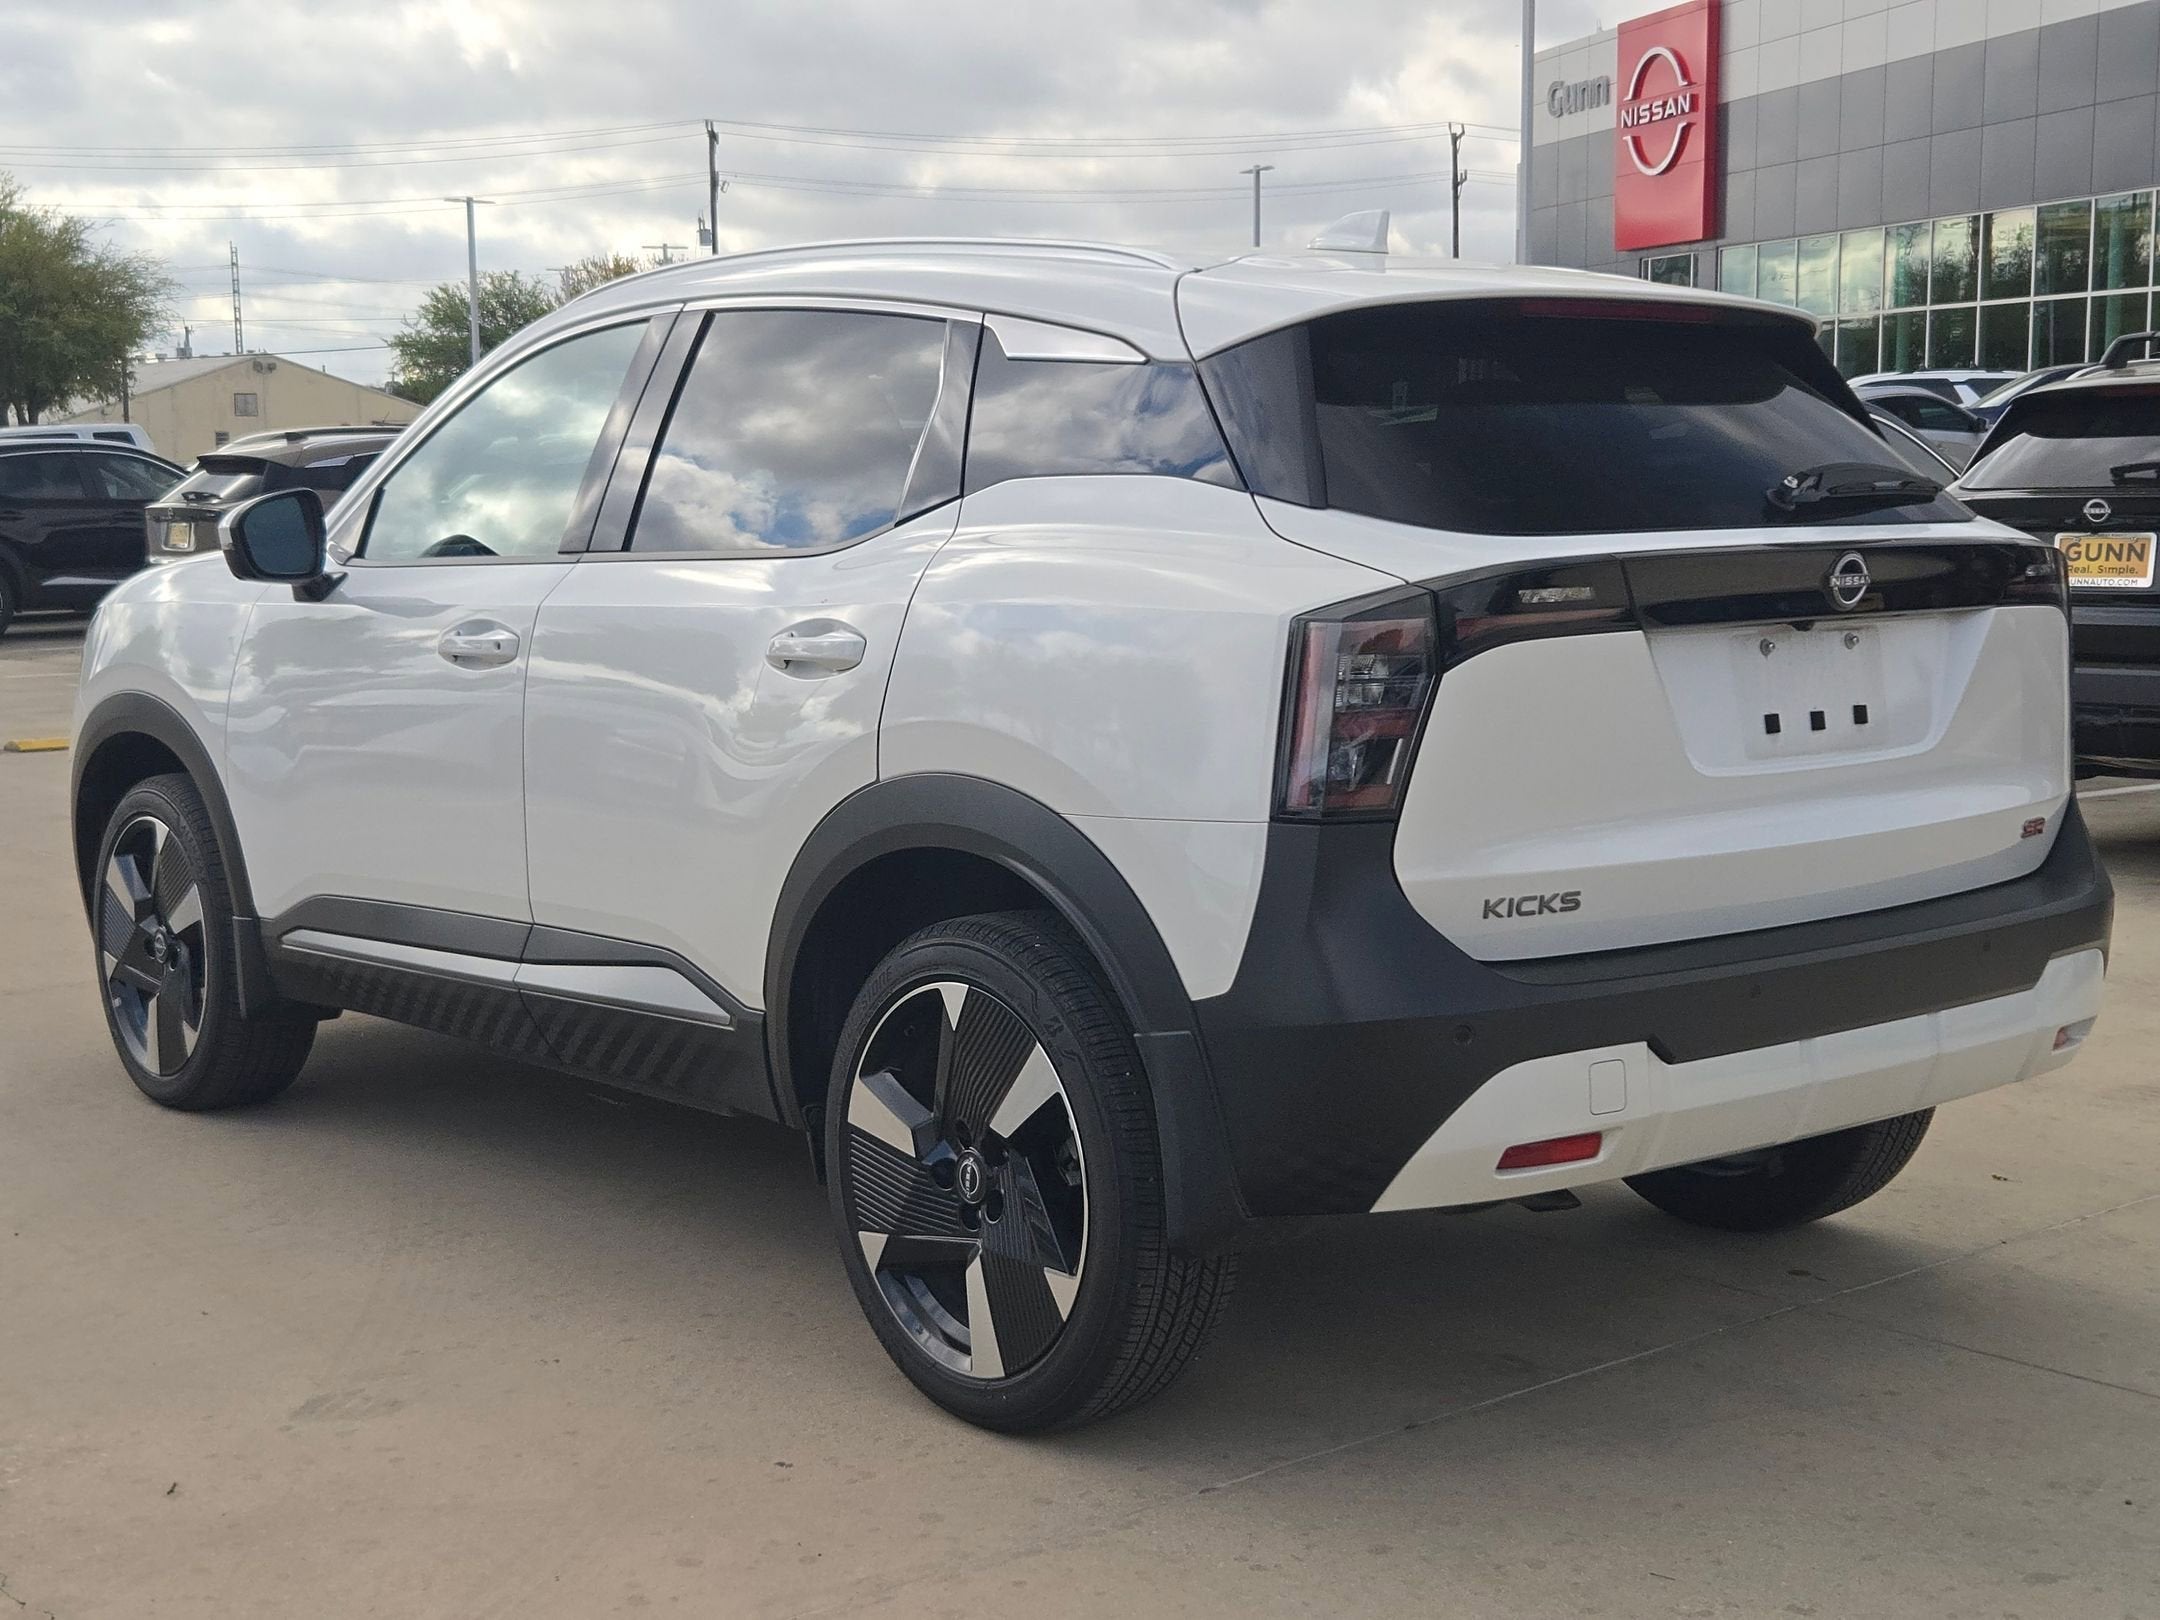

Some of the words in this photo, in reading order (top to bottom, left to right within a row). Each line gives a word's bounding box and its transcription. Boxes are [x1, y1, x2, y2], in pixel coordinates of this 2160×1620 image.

[1547, 75, 1611, 118] Gunn
[1620, 93, 1690, 128] NISSAN
[2065, 542, 2146, 562] GUNN
[2067, 565, 2092, 574] Real.
[2097, 565, 2139, 576] Simple.
[1829, 575, 1871, 587] NISSAN
[2070, 578, 2139, 586] UNNAUTO.COM
[1482, 890, 1582, 919] KICKS
